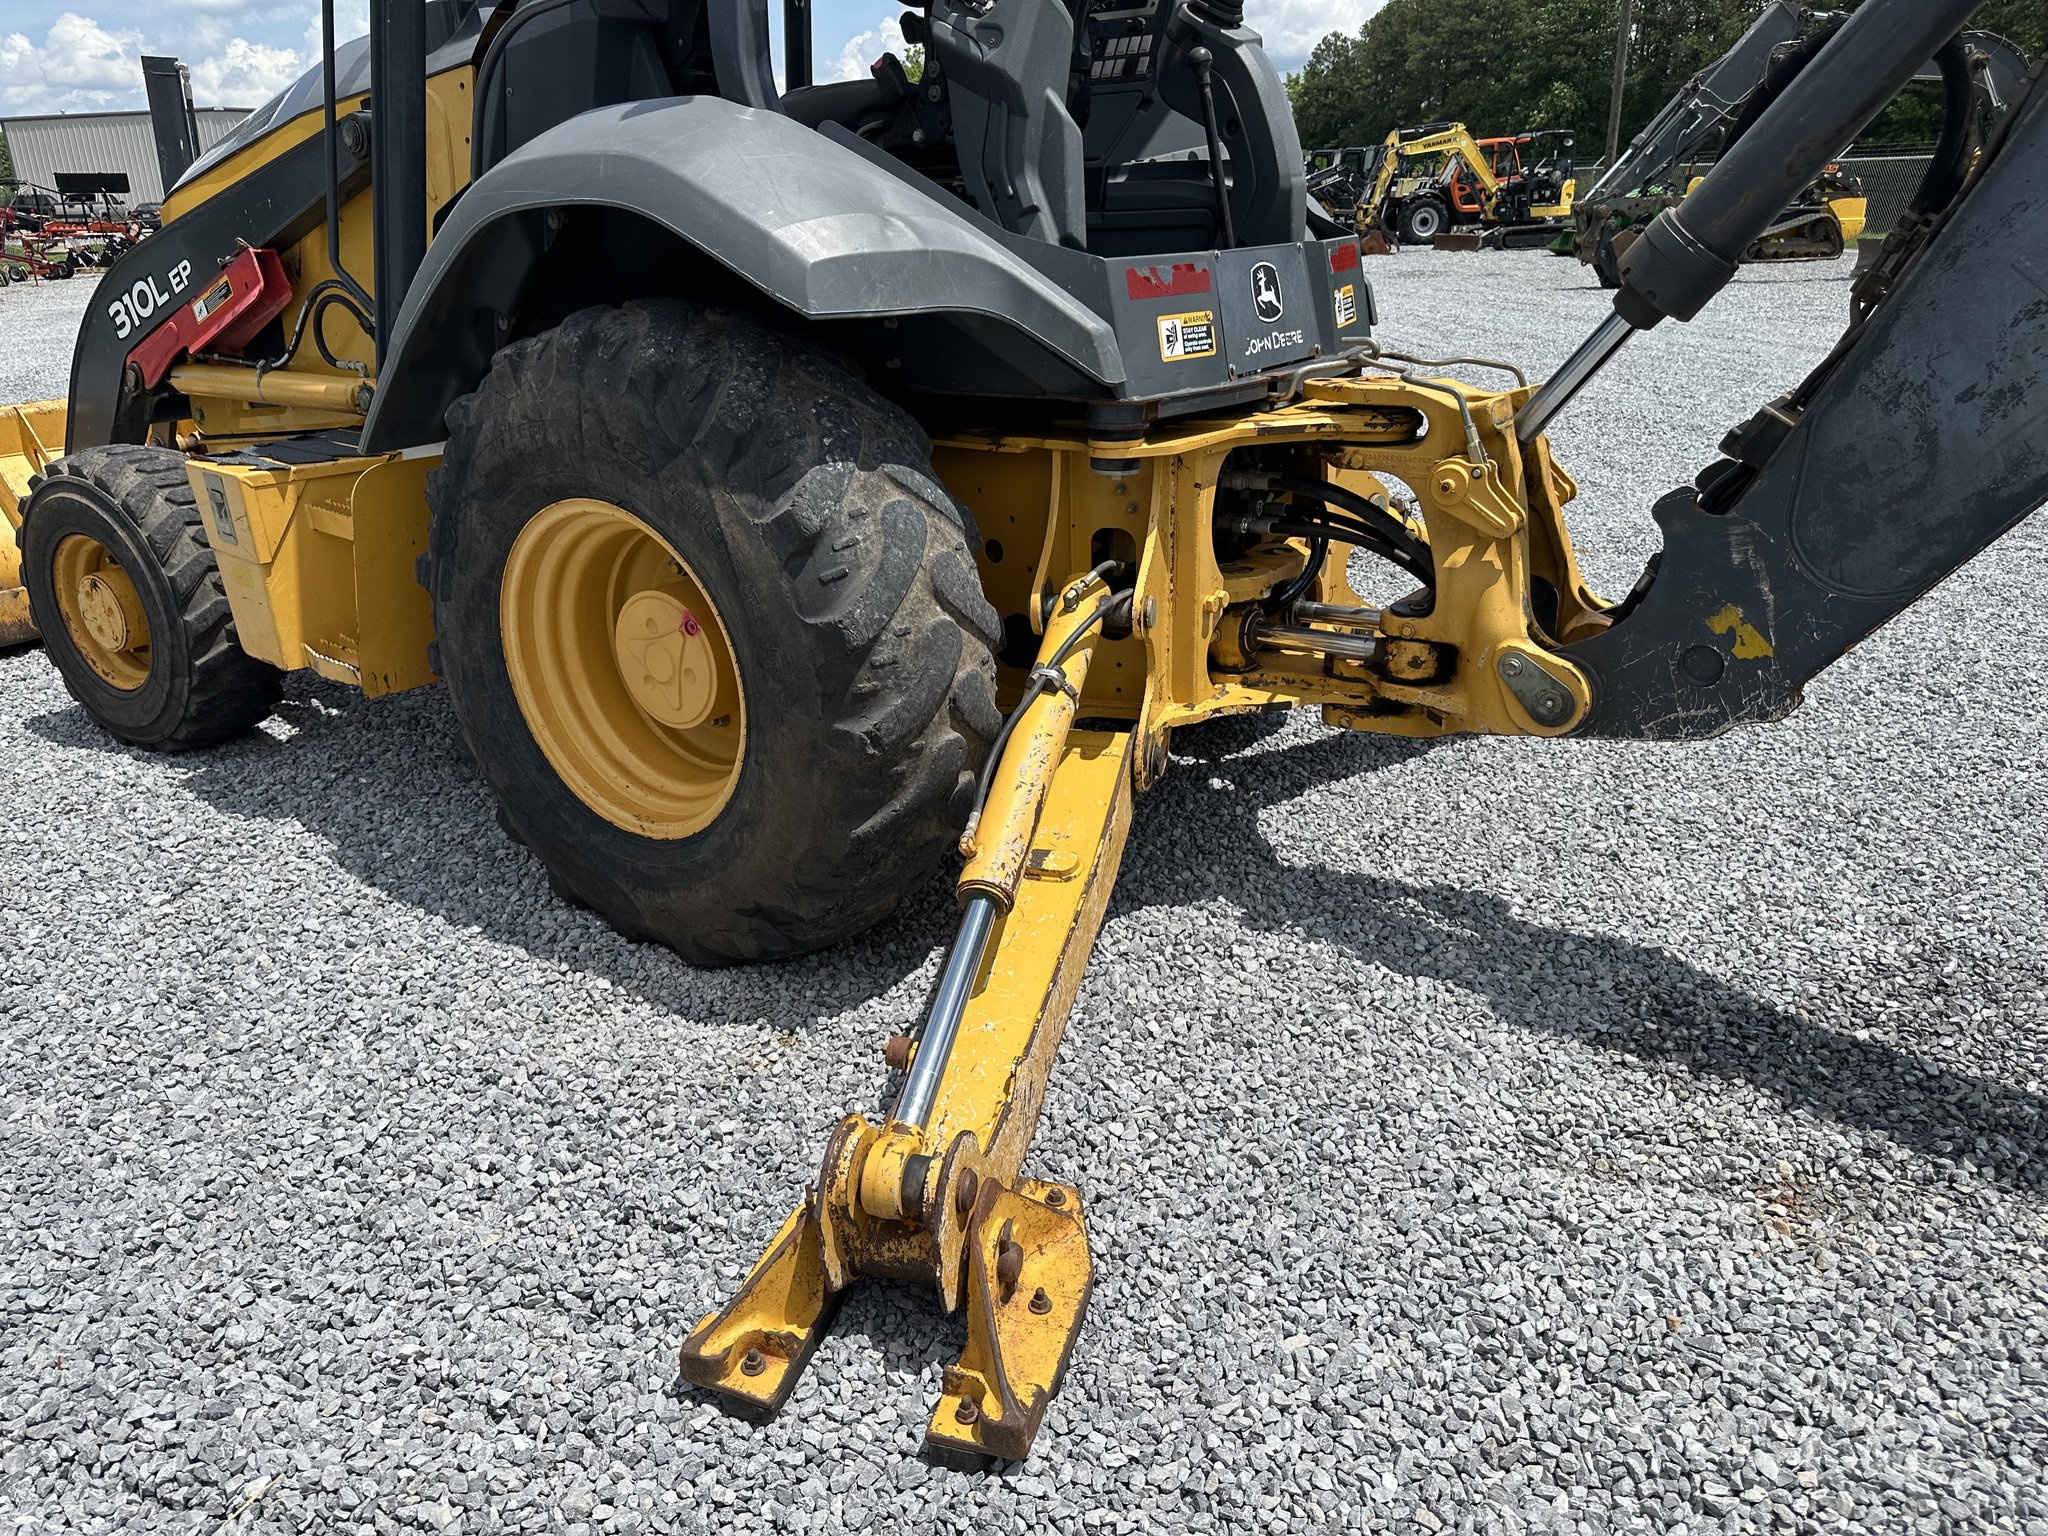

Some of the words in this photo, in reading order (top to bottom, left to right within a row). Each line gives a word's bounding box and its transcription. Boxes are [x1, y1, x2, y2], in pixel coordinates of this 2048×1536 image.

[1422, 138, 1452, 149] YANMAR
[107, 274, 171, 340] 310L
[167, 258, 193, 295] EP
[1182, 326, 1194, 334] STAY
[1244, 335, 1273, 356] JOHN
[1271, 329, 1304, 350] DEERE
